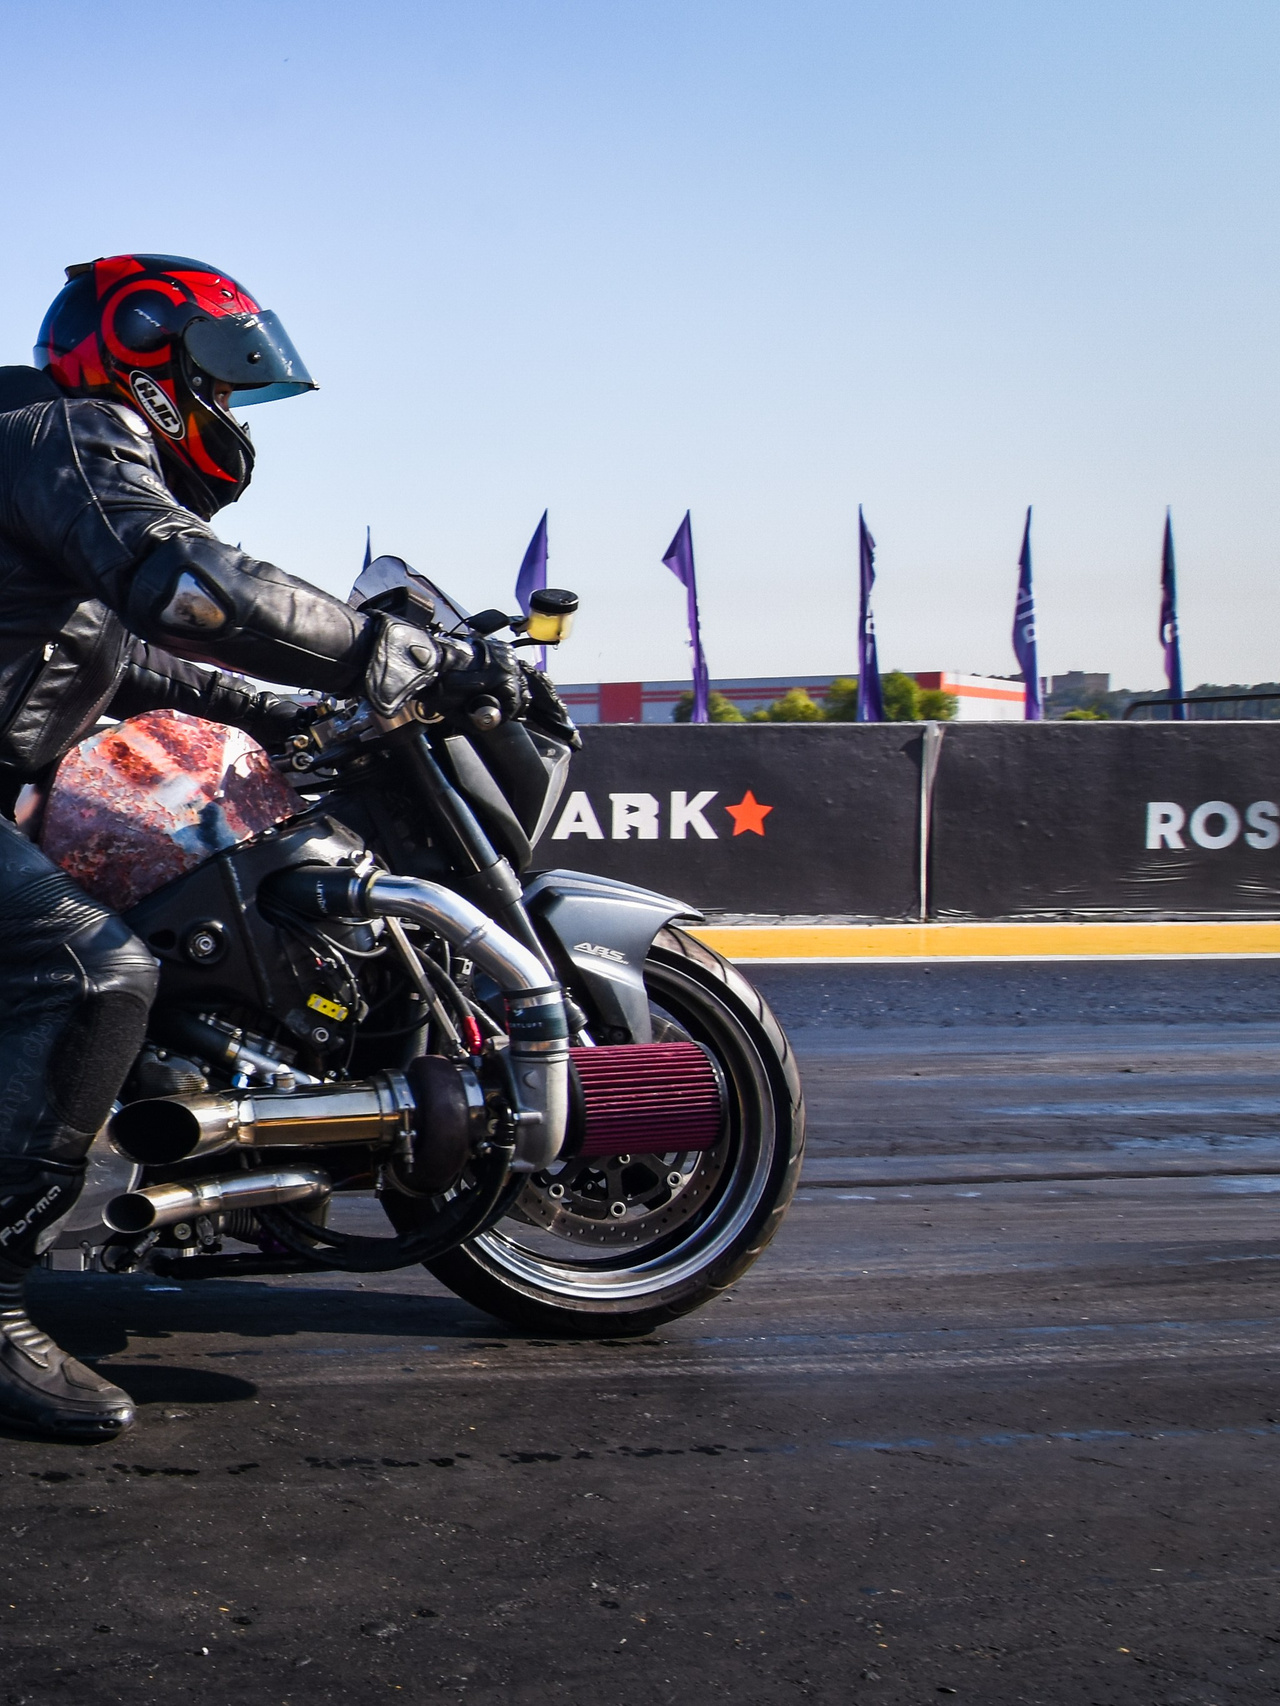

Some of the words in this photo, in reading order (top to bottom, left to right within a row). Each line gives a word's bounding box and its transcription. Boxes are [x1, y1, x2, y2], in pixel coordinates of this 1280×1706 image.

[136, 382, 179, 427] HJC
[551, 791, 719, 840] ARK
[1145, 800, 1280, 850] ROS
[573, 942, 627, 963] ABS
